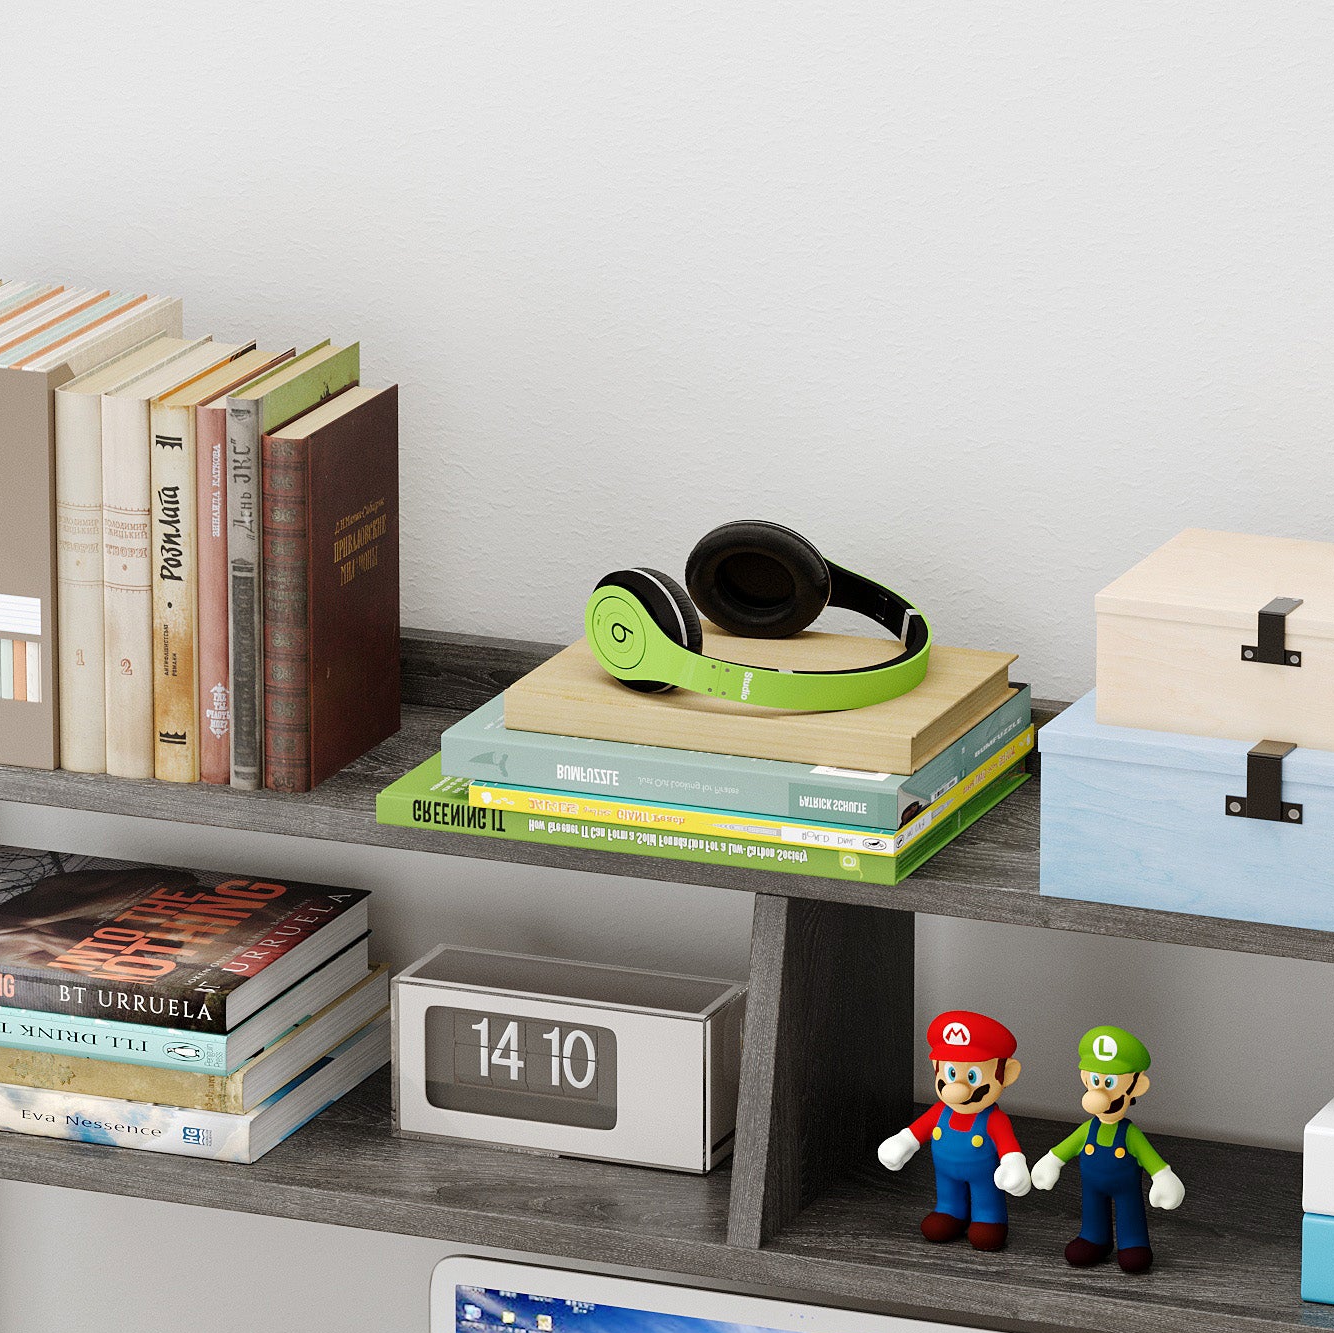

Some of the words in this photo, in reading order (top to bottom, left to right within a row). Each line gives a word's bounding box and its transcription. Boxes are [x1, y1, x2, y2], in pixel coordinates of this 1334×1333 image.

[158, 486, 183, 581] Розплата
[76, 649, 85, 665] 1
[120, 658, 133, 676] 2
[740, 671, 754, 701] Studio
[47, 927, 146, 972] INTO
[114, 887, 208, 924] THE
[222, 892, 352, 974] URRUELA
[59, 985, 87, 1004] BT
[98, 989, 213, 1021] URRUELA
[19, 1024, 98, 1046] DRINK
[945, 1026, 968, 1043] M
[1098, 1038, 1113, 1057] L
[471, 1017, 524, 1081] 14
[542, 1026, 596, 1090] 10
[21, 1109, 56, 1123] Eva
[66, 1115, 163, 1137] Nessence
